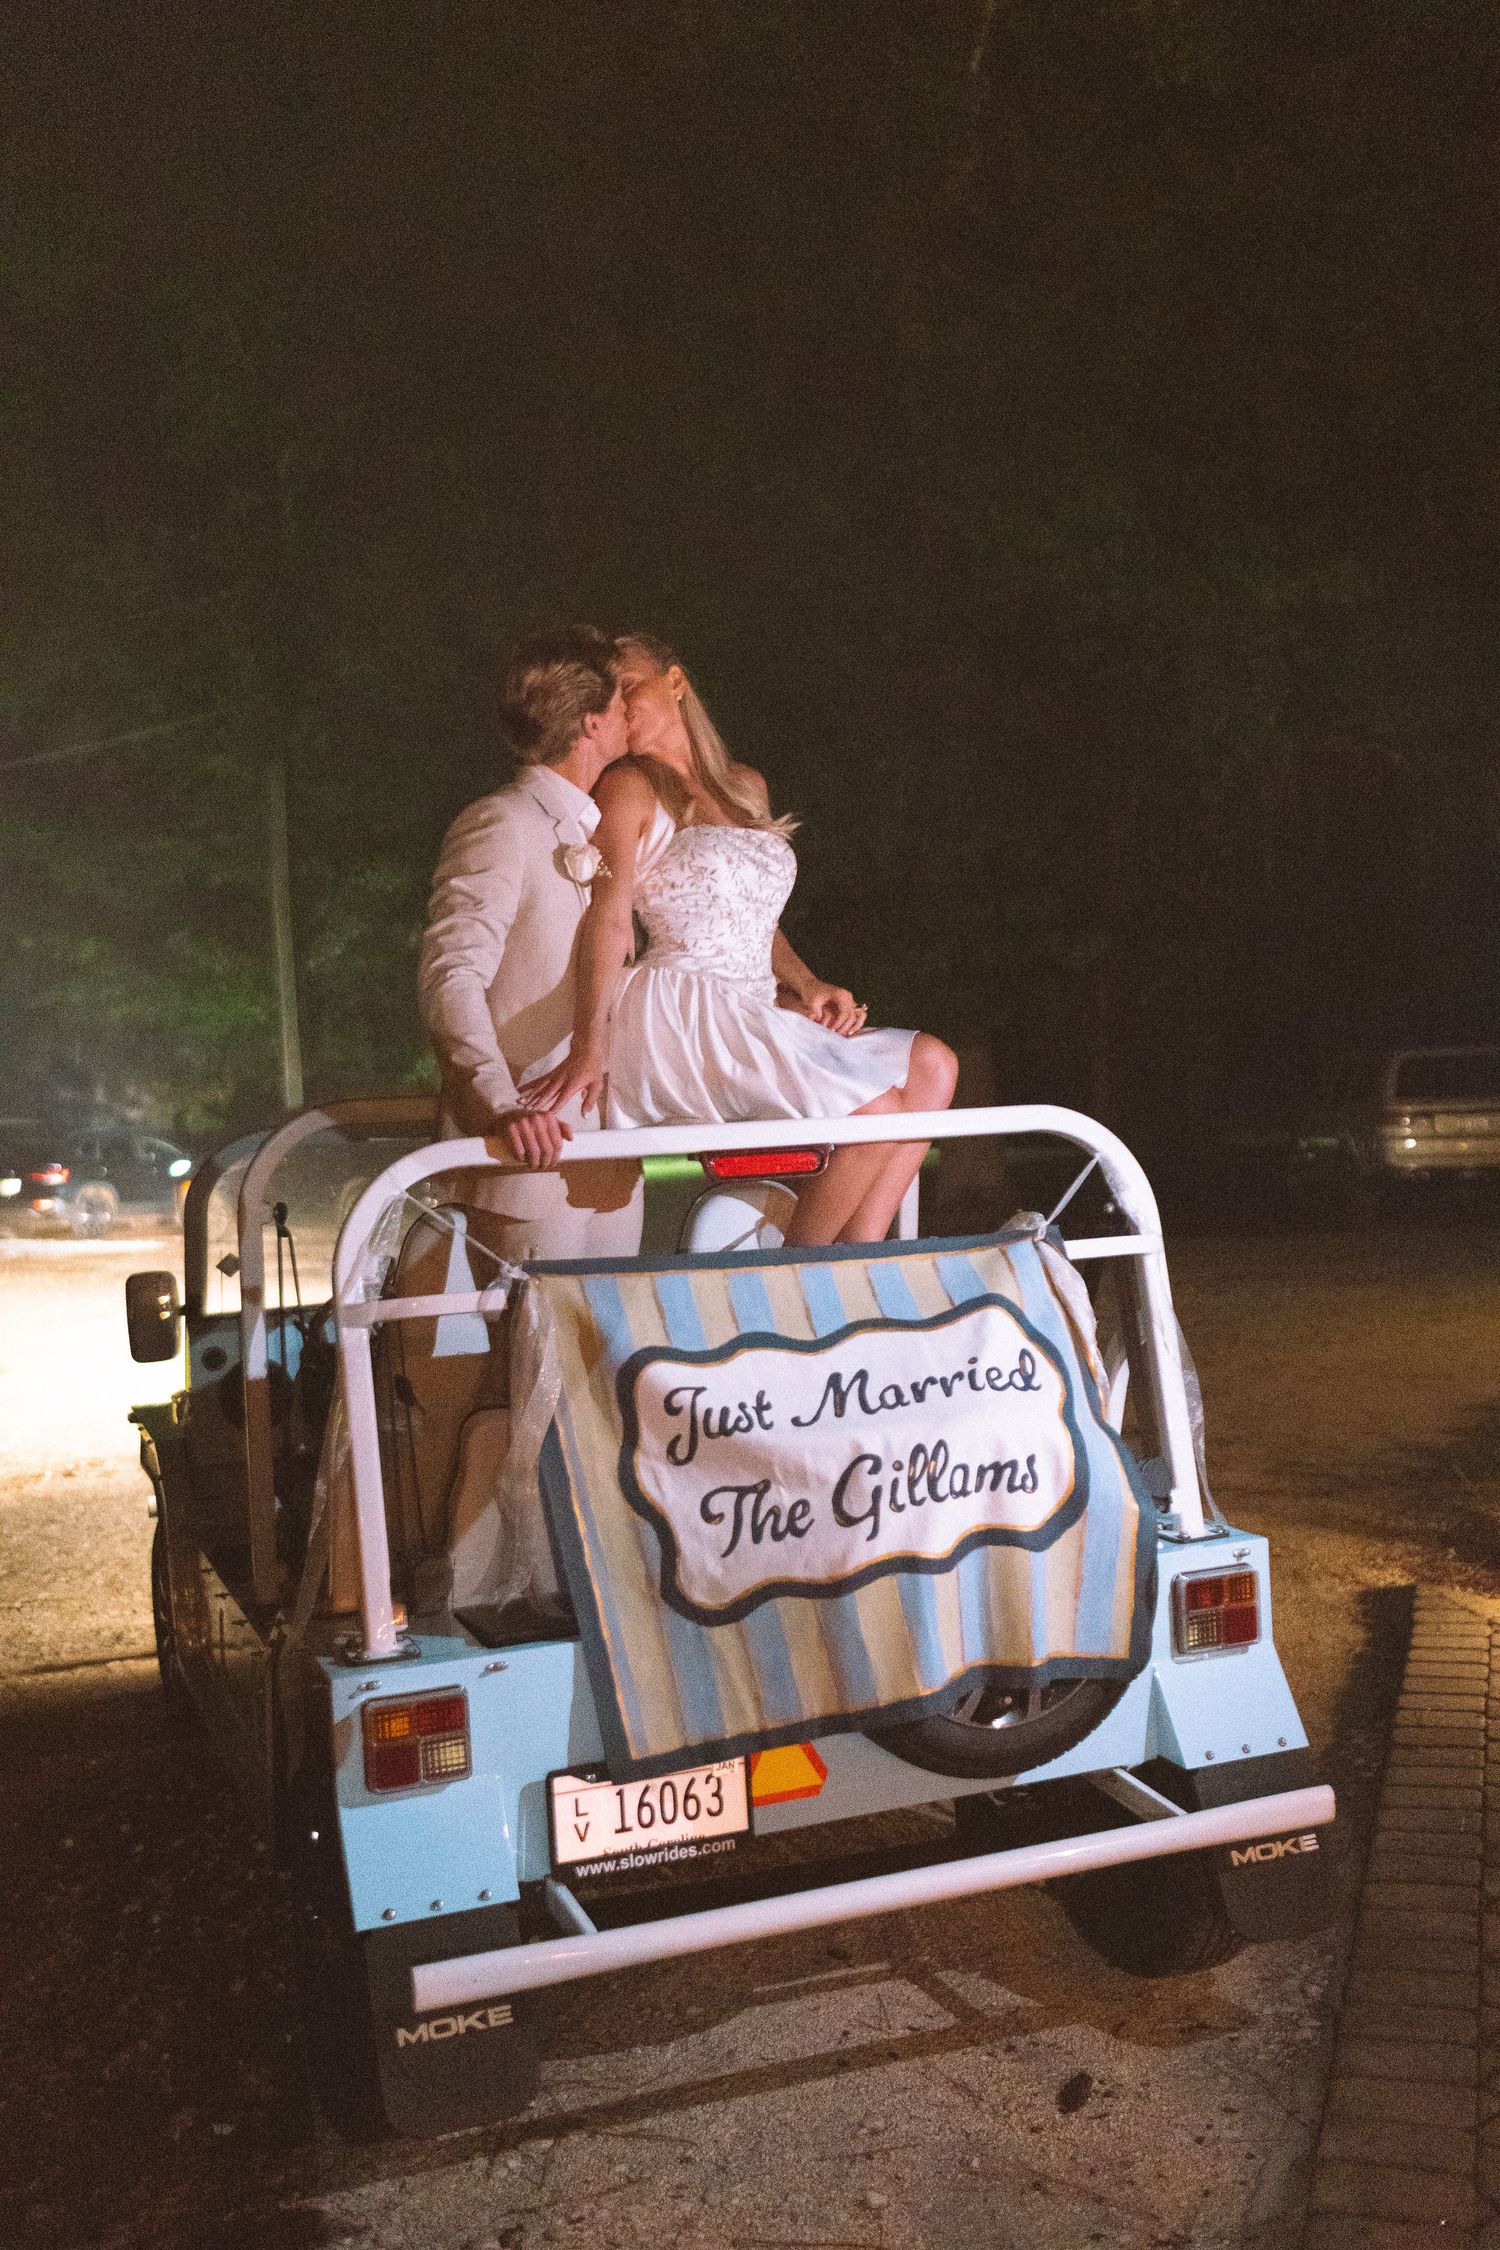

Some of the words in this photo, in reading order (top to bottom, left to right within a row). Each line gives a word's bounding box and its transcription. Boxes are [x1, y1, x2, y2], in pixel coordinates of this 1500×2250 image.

[664, 1386, 775, 1466] Just
[791, 1348, 1042, 1427] Married
[700, 1479, 814, 1558] The
[832, 1440, 1040, 1541] Gillams
[716, 1761, 735, 1771] JAN
[614, 1773, 724, 1834] 16063
[575, 1837, 736, 1877] www.slowrides.com
[1230, 1833, 1320, 1867] MOKE
[396, 2004, 514, 2048] MOKE
